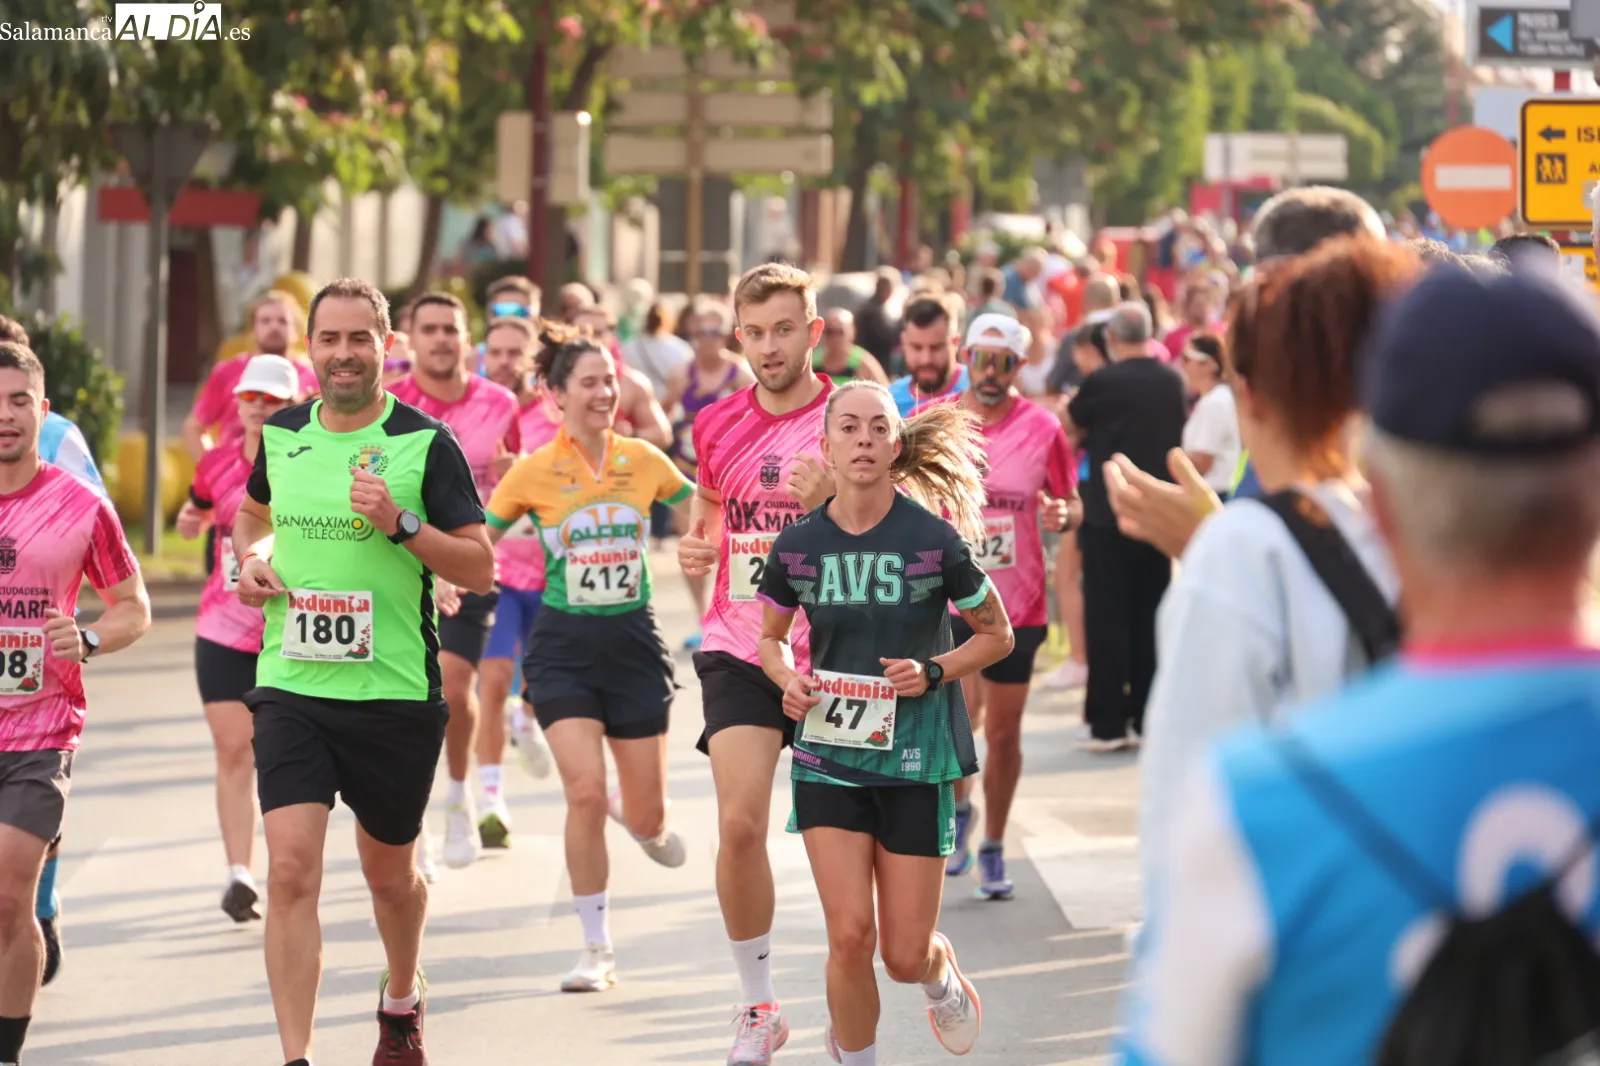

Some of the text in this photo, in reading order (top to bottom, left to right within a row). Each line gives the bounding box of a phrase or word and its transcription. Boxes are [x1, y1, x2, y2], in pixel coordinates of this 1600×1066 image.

[1577, 127, 1600, 143] IS
[765, 501, 804, 509] CIUDADE
[275, 515, 364, 530] SANMAXIMO
[765, 512, 804, 531] MA
[301, 528, 357, 540] TELECOM
[580, 564, 630, 590] 412
[818, 551, 904, 605] AVS
[288, 591, 369, 613] bedunia
[296, 613, 355, 645] 180
[812, 674, 895, 700] bedunia
[825, 697, 867, 730] 47
[902, 748, 921, 759] AVS
[901, 761, 921, 771] 1990
